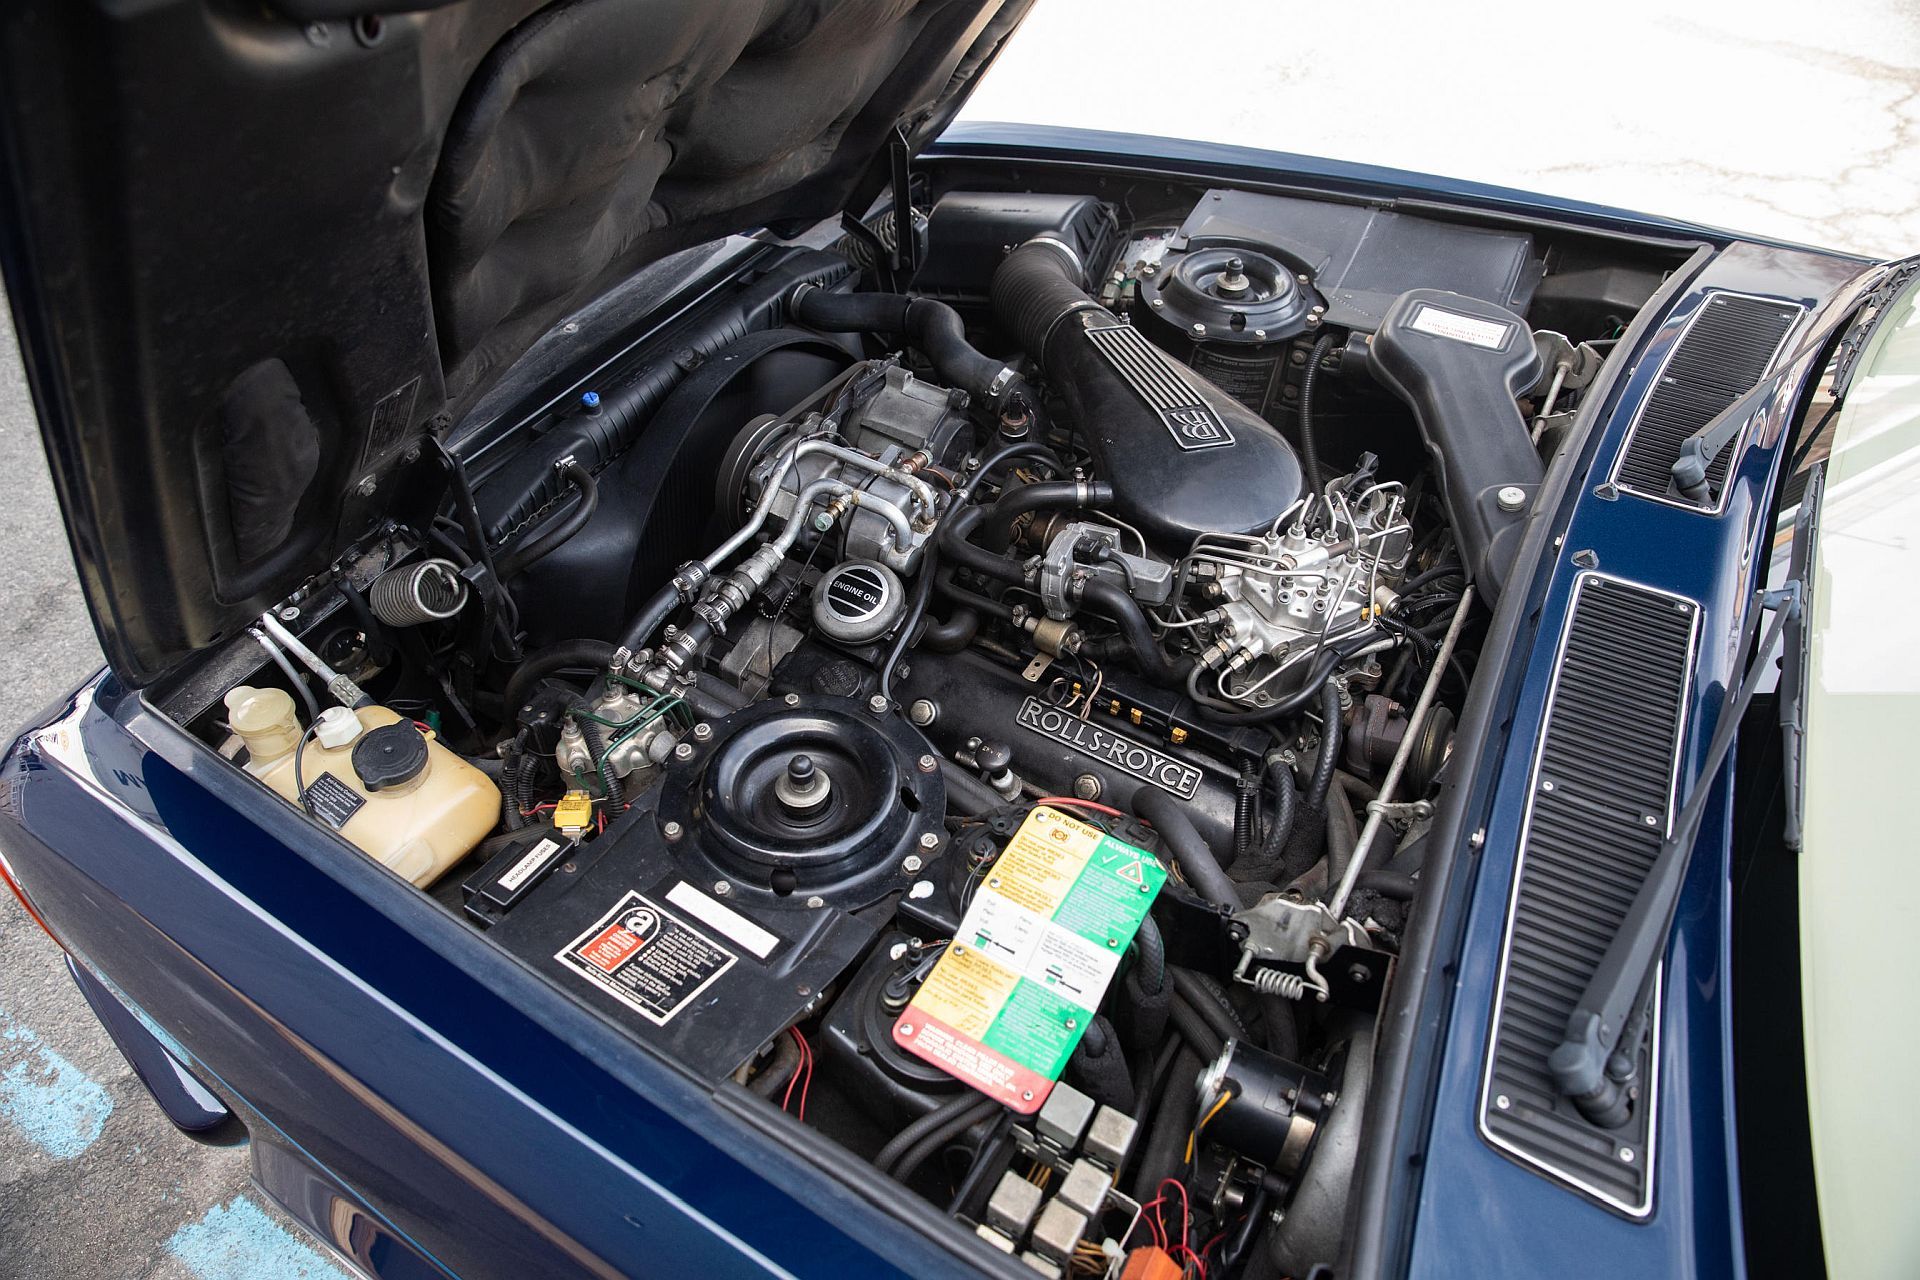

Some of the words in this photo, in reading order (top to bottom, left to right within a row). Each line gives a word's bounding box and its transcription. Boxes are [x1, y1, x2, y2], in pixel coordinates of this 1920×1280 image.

[833, 581, 863, 597] ENGINE
[863, 593, 877, 604] OIL
[1020, 700, 1197, 794] ROLLS-ROYCE
[1049, 812, 1061, 821] DO
[1062, 819, 1080, 830] NOT
[1081, 828, 1099, 840] USE
[1104, 839, 1139, 859] ALWAYS
[508, 857, 536, 882] HEADLAMP
[535, 844, 551, 858] FUSES
[625, 911, 655, 935] a
